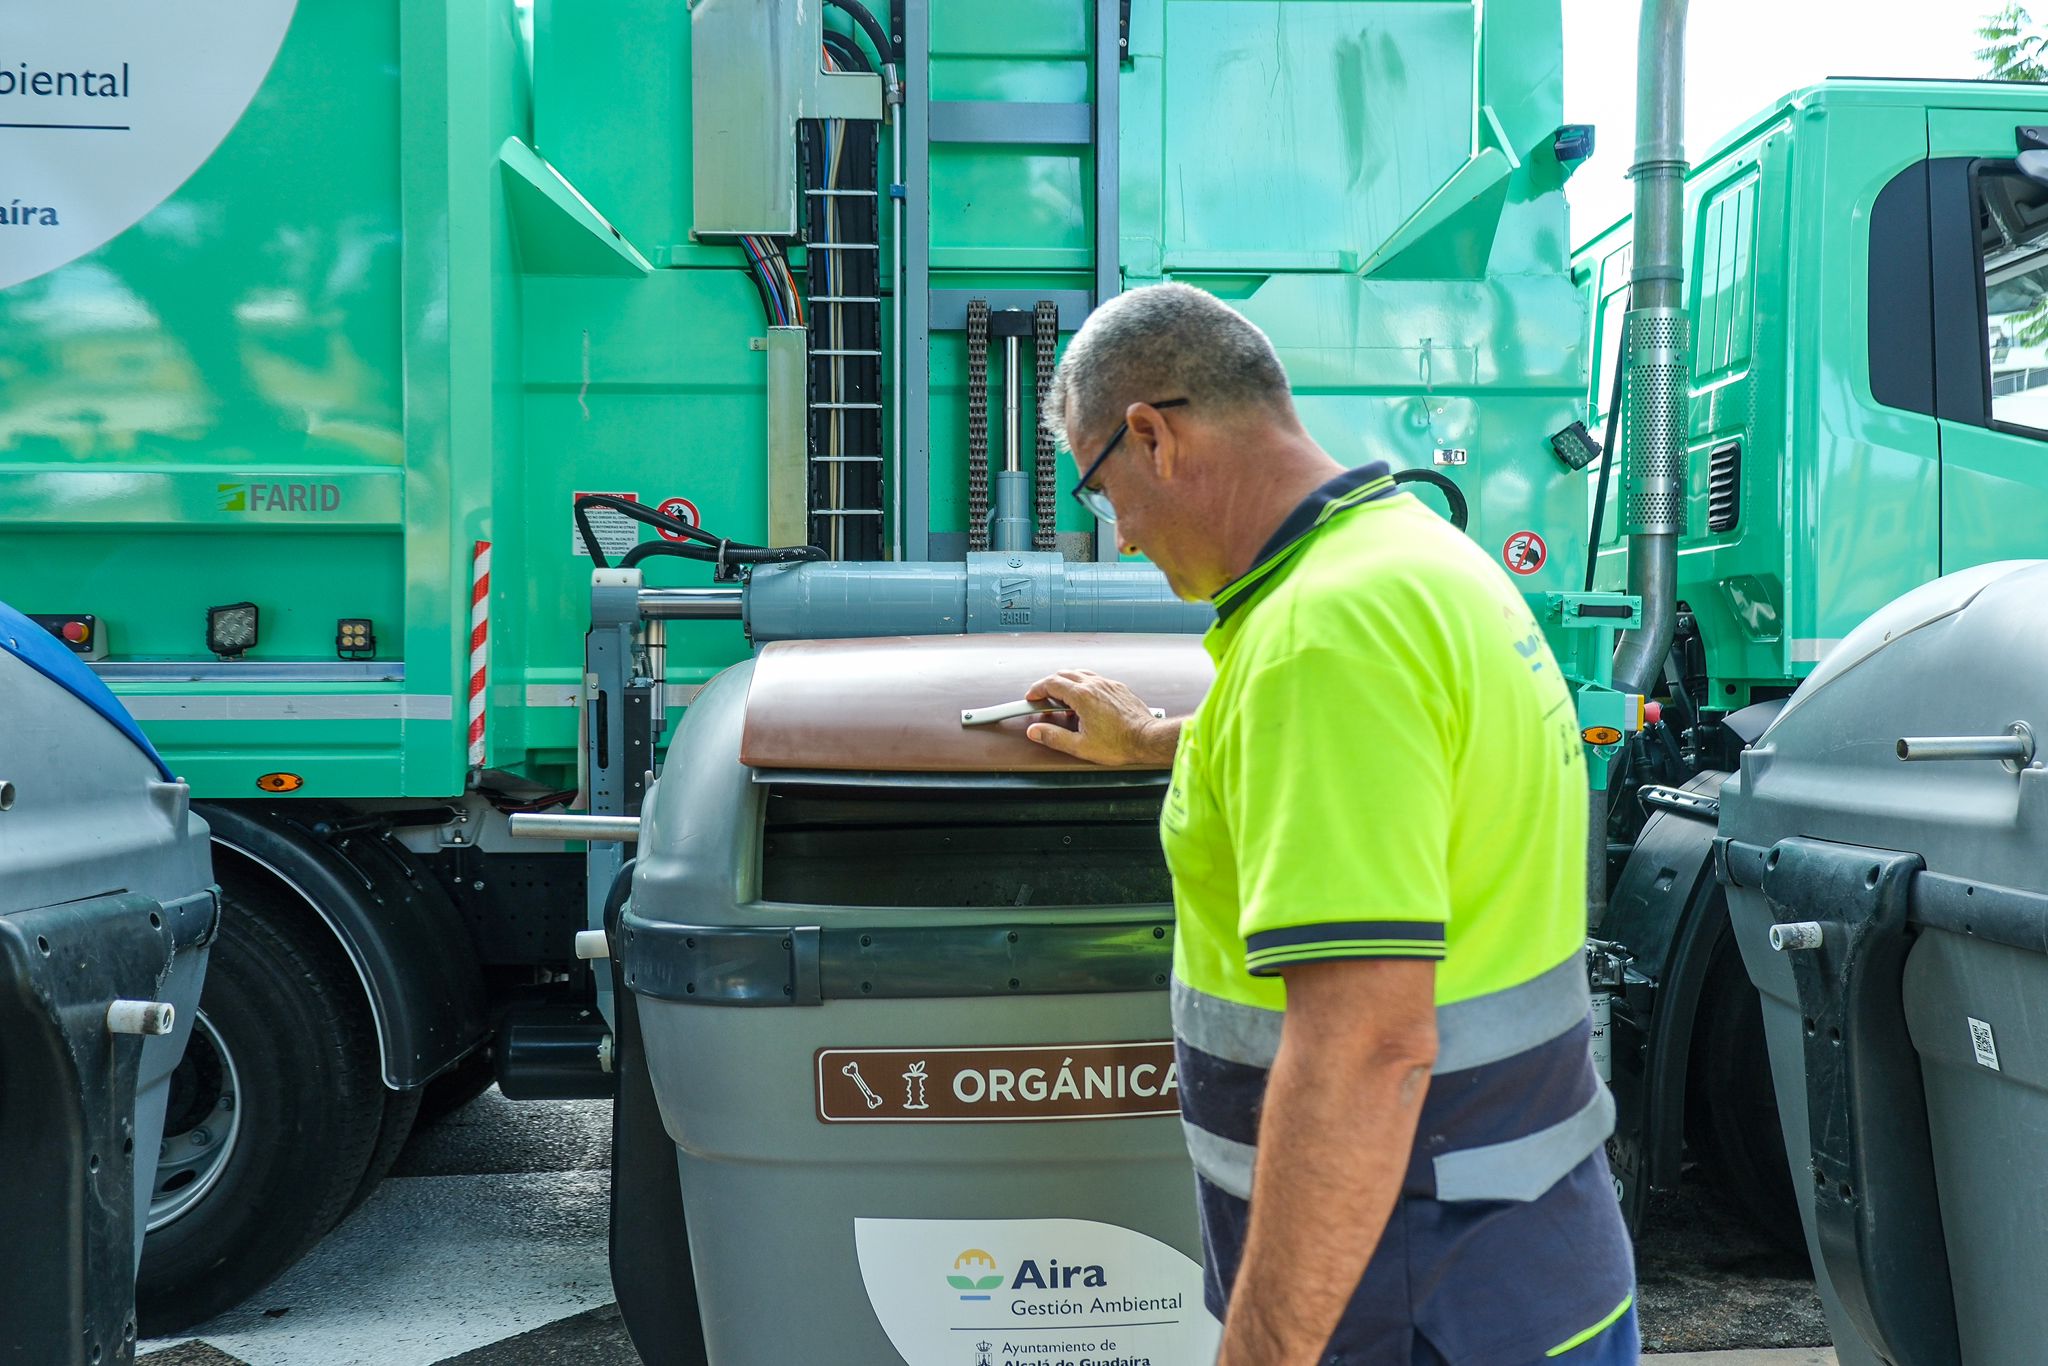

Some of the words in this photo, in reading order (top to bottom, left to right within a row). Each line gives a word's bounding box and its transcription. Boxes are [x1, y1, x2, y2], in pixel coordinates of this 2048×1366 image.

[250, 484, 341, 512] FARID
[1000, 611, 1031, 625] FARID
[952, 1056, 1181, 1104] ORGÁNICA
[1011, 1258, 1107, 1290] Aira
[1011, 1299, 1083, 1316] Gestión
[1090, 1292, 1182, 1314] Ambiental
[1001, 1340, 1096, 1357] Ayuntamiento
[1100, 1338, 1117, 1351] de
